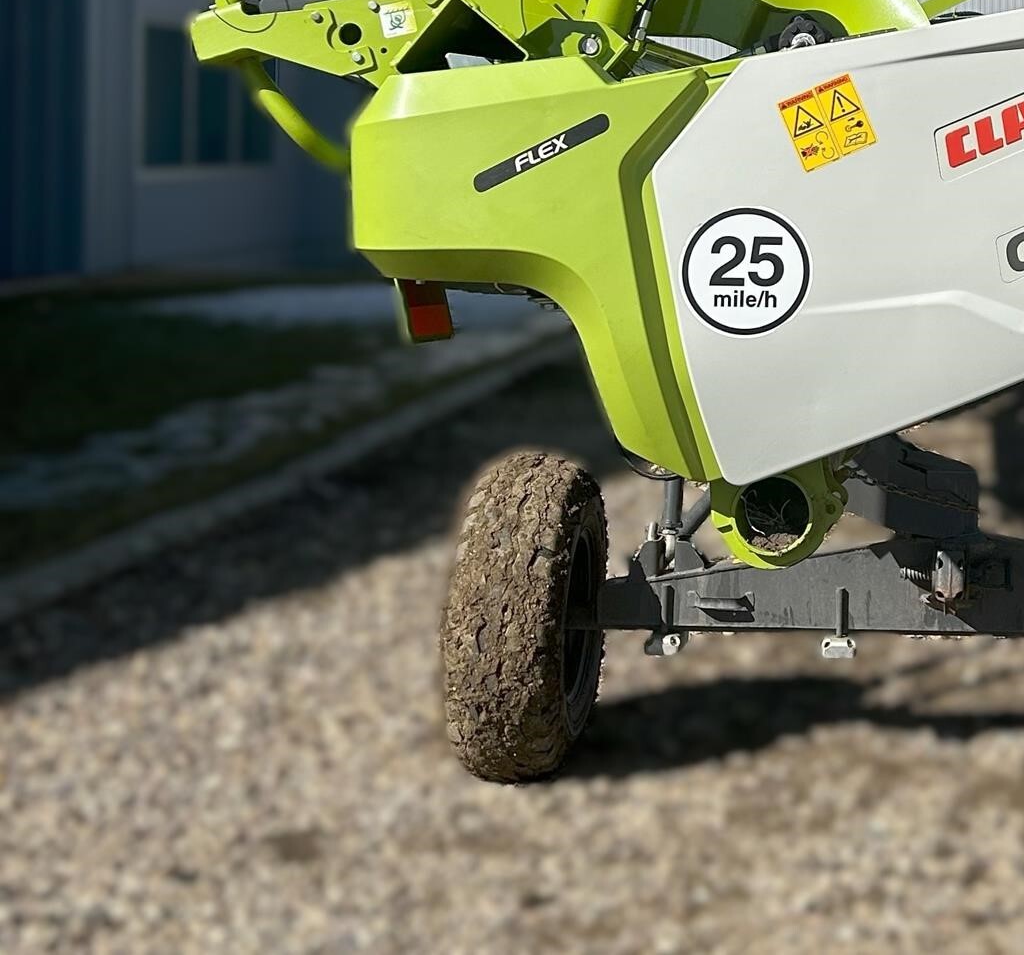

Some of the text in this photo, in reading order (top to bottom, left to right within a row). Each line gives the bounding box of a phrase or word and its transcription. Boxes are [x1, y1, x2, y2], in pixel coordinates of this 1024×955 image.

[515, 133, 569, 173] FLEX
[708, 235, 785, 287] 25
[713, 289, 777, 308] mile/h
